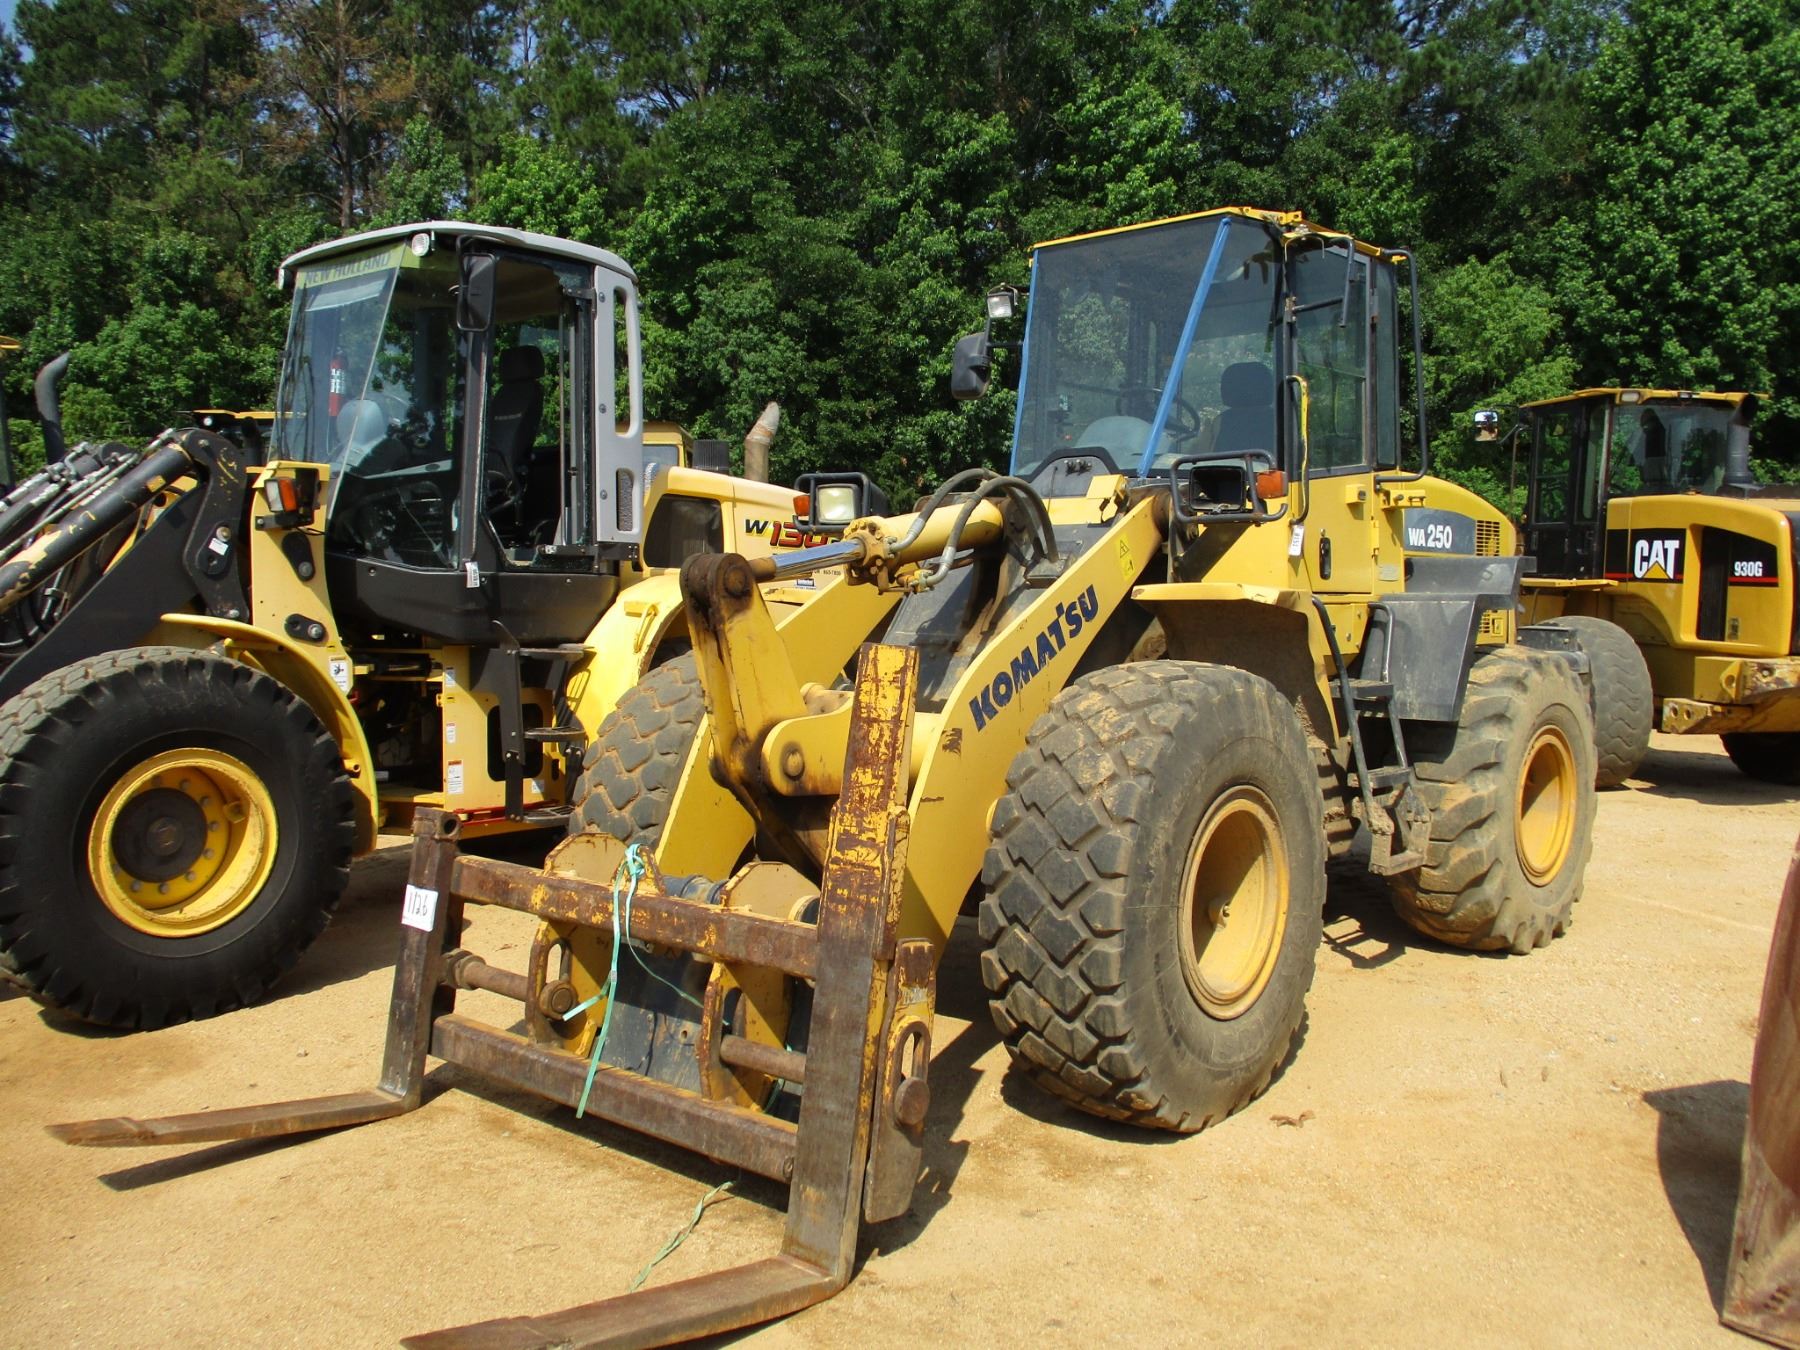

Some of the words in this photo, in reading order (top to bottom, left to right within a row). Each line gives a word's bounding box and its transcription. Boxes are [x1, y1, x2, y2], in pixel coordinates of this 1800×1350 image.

[745, 518, 840, 549] W130
[1633, 539, 1680, 580] CAT
[1734, 560, 1763, 577] 930G
[968, 583, 1099, 733] KOMATSU
